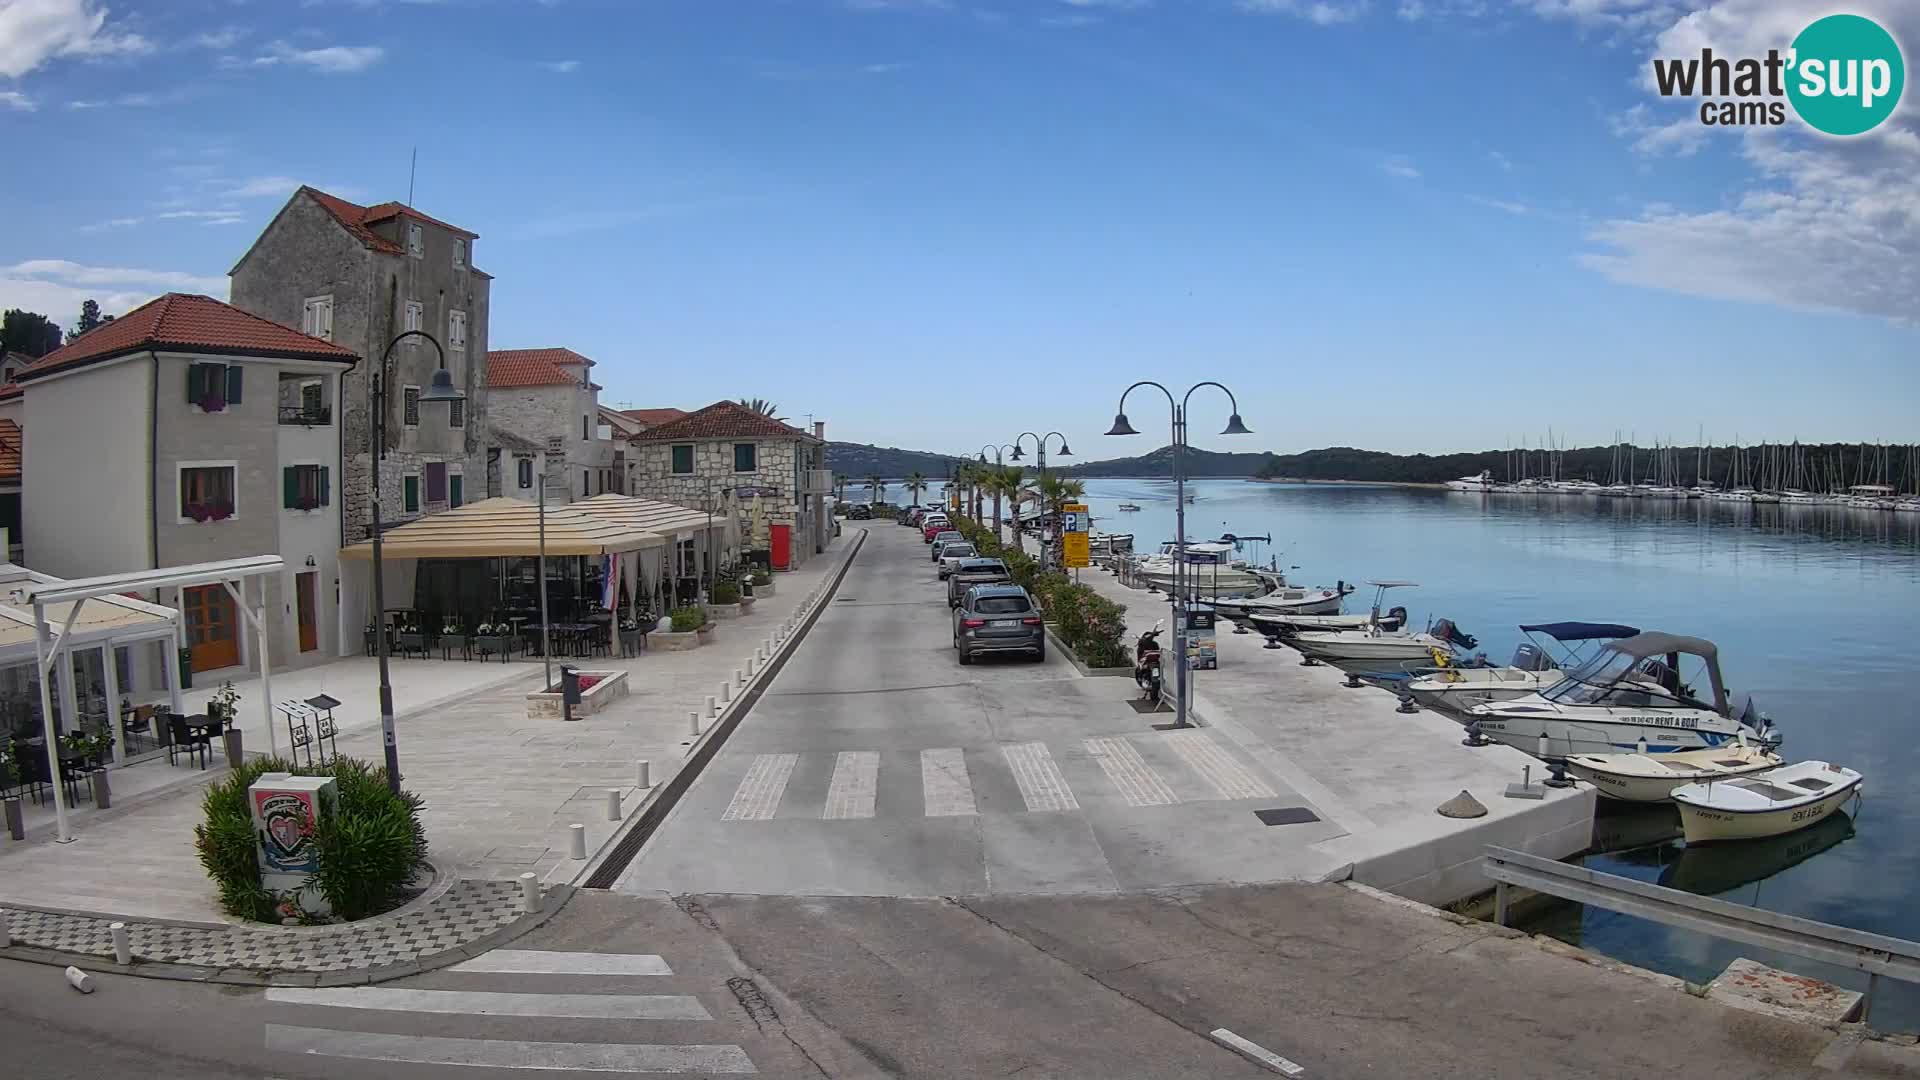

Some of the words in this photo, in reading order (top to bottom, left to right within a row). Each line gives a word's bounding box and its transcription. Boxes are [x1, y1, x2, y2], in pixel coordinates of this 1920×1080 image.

[1065, 514, 1076, 530] P
[1655, 716, 1673, 727] RENT
[1675, 717, 1680, 727] A
[1681, 717, 1699, 728] BOAT
[1791, 810, 1806, 823] RENT
[1812, 803, 1826, 817] BOAT
